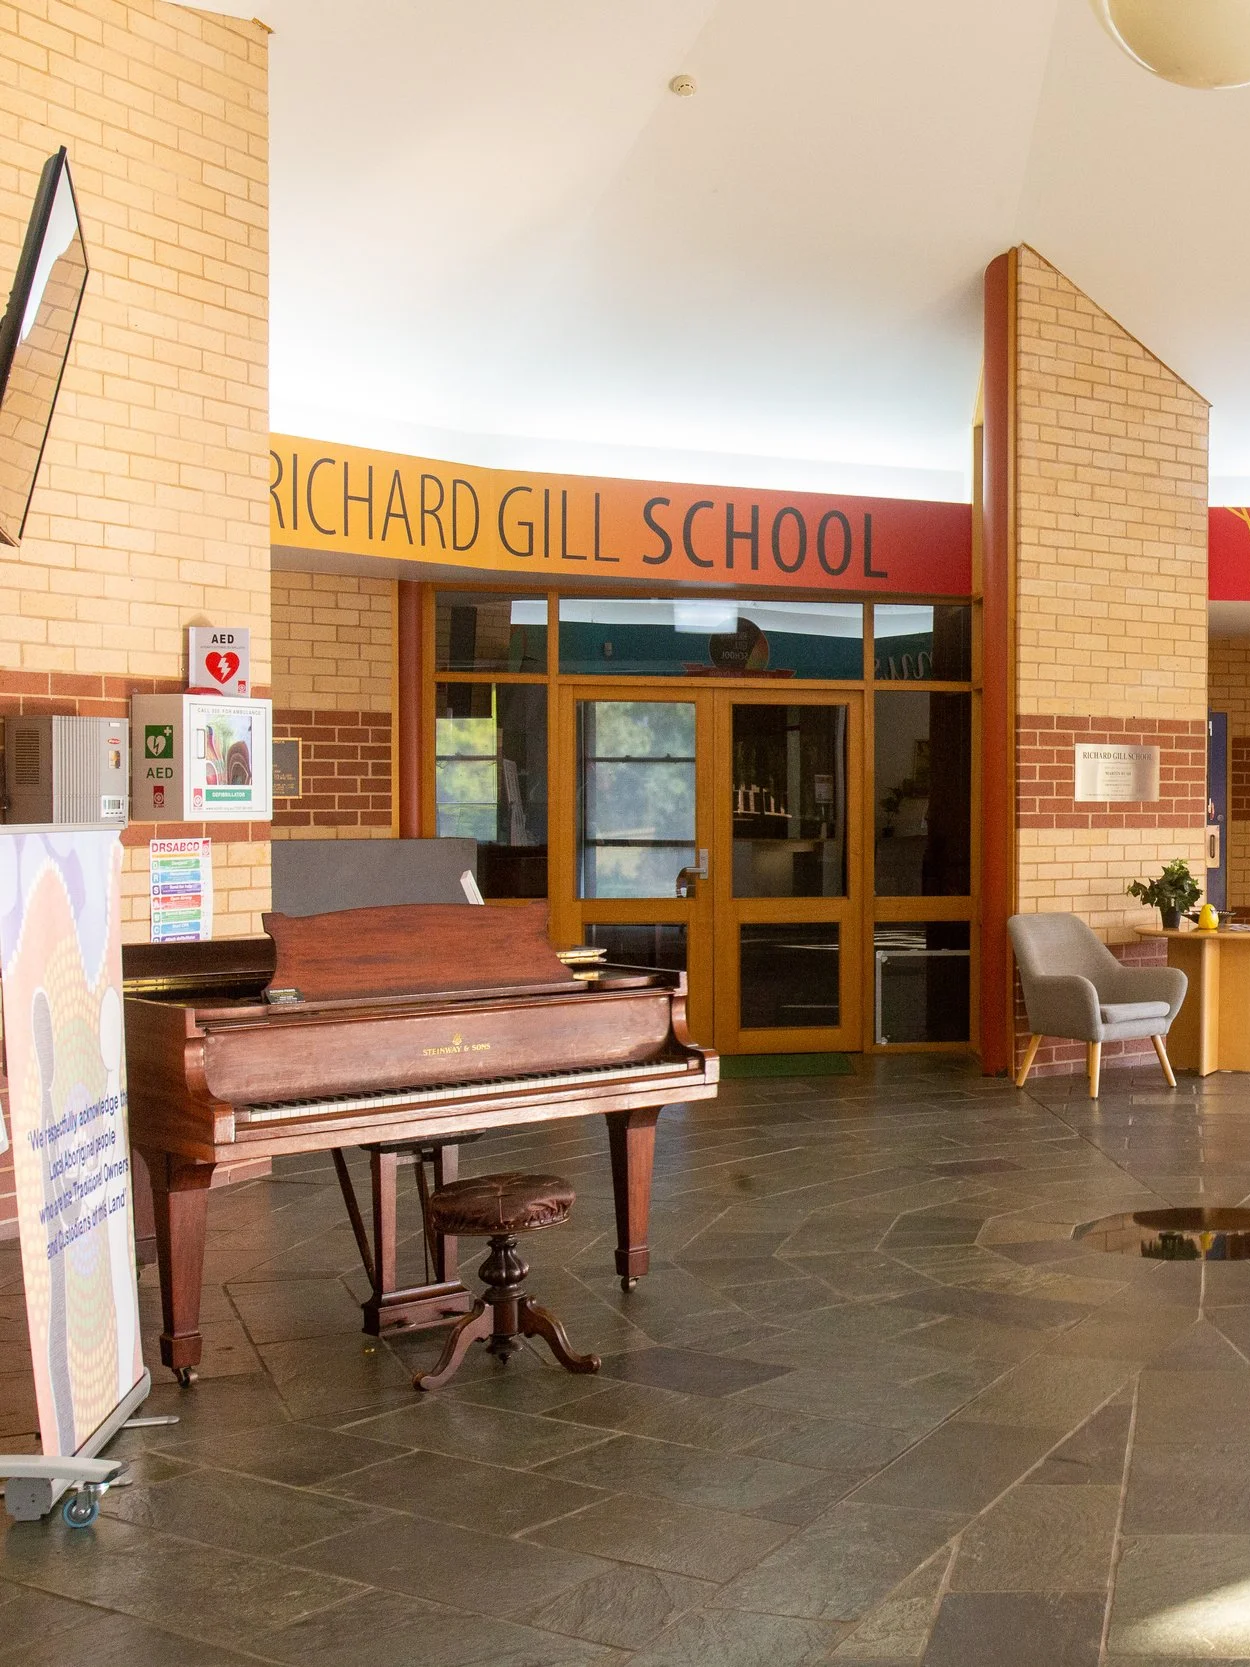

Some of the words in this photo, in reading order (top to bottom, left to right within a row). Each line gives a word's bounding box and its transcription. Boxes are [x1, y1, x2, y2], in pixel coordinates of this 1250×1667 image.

[270, 450, 480, 551] RICHARD
[497, 486, 620, 563] GILL
[641, 497, 888, 579] SCHOOL
[211, 633, 235, 644] AED
[1082, 751, 1112, 760] RICHARD
[1112, 752, 1127, 761] GILL
[146, 767, 174, 779] AED
[151, 841, 200, 853] DRSABCD
[422, 1046, 462, 1056] STEINWAY
[463, 1044, 470, 1052] &
[471, 1043, 491, 1051] SONS
[80, 1094, 118, 1126] acknowledge
[103, 1157, 129, 1182] Owners
